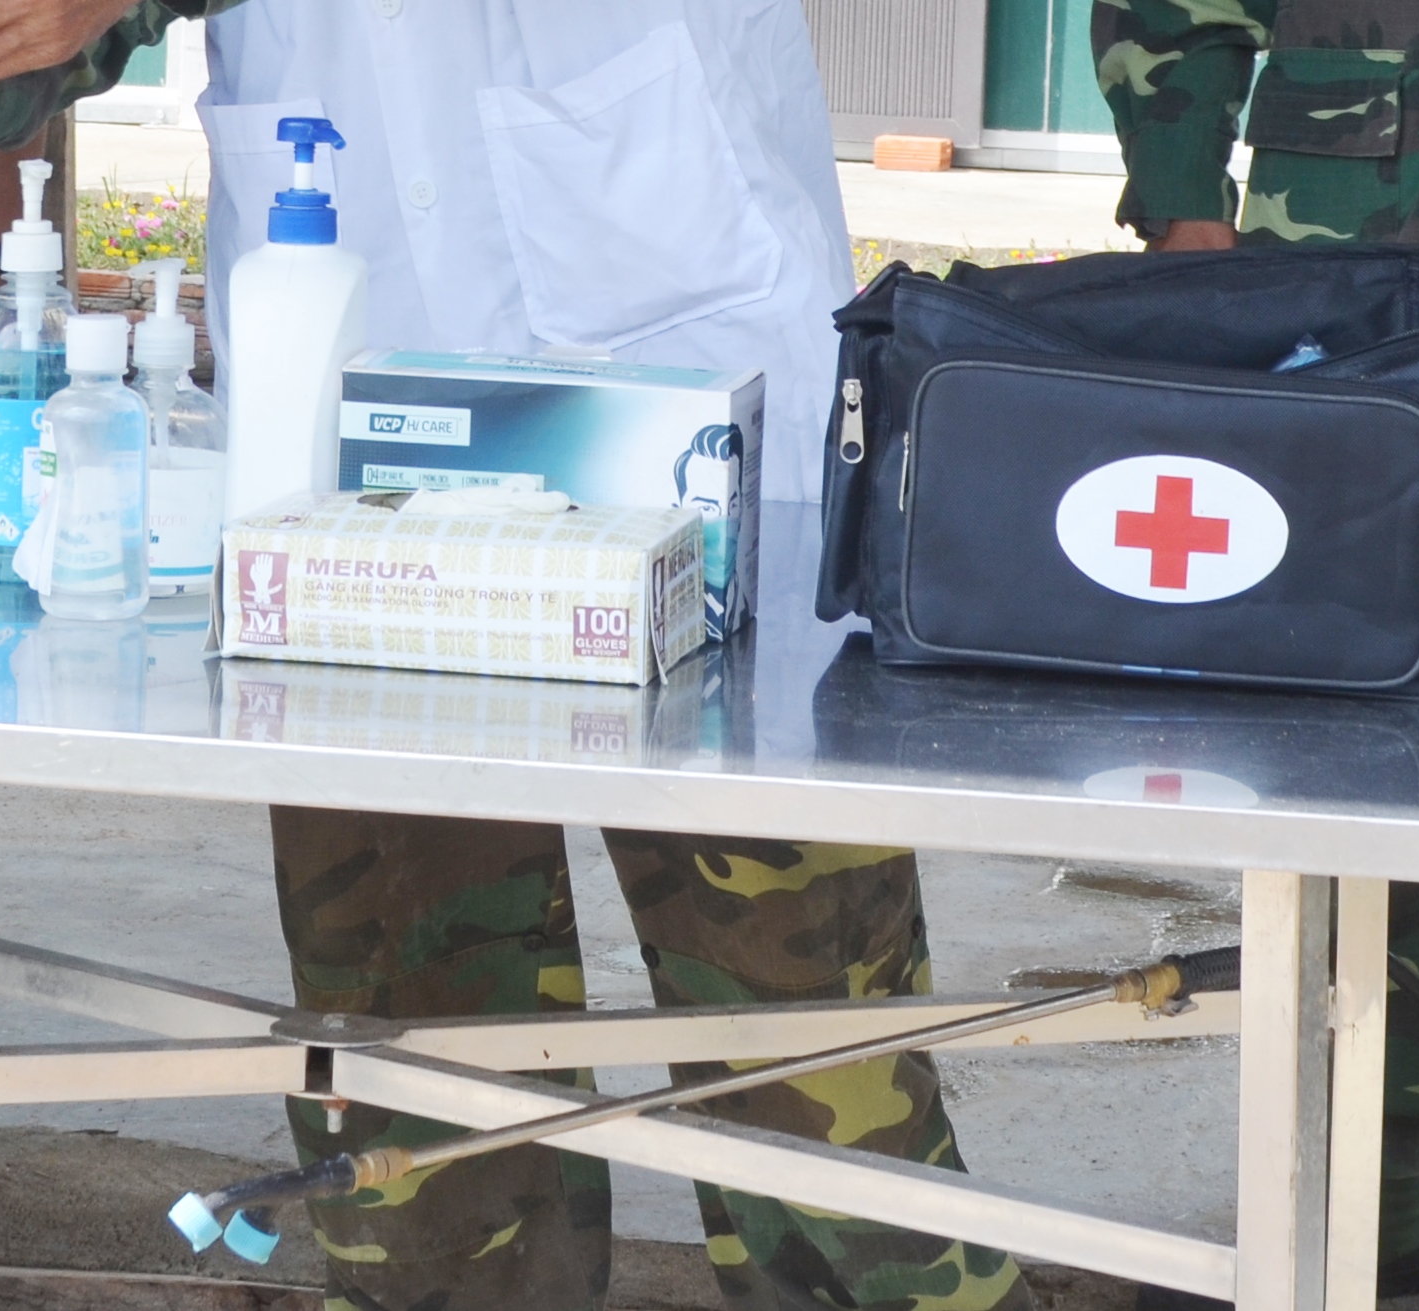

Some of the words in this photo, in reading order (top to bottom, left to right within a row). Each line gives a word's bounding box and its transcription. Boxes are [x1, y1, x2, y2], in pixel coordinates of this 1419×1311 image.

[373, 416, 402, 431] VCP
[422, 420, 452, 433] CARE
[305, 557, 438, 581] MERUFA
[303, 594, 344, 603] MEDICAL
[347, 595, 409, 607] EXAMINATION
[390, 585, 419, 596] TRA
[470, 589, 520, 602] TRONG
[525, 592, 533, 603] Y
[245, 609, 282, 636] M
[576, 608, 626, 637] 100
[241, 631, 286, 645] MEDIUM
[575, 638, 627, 651] GLOVES
